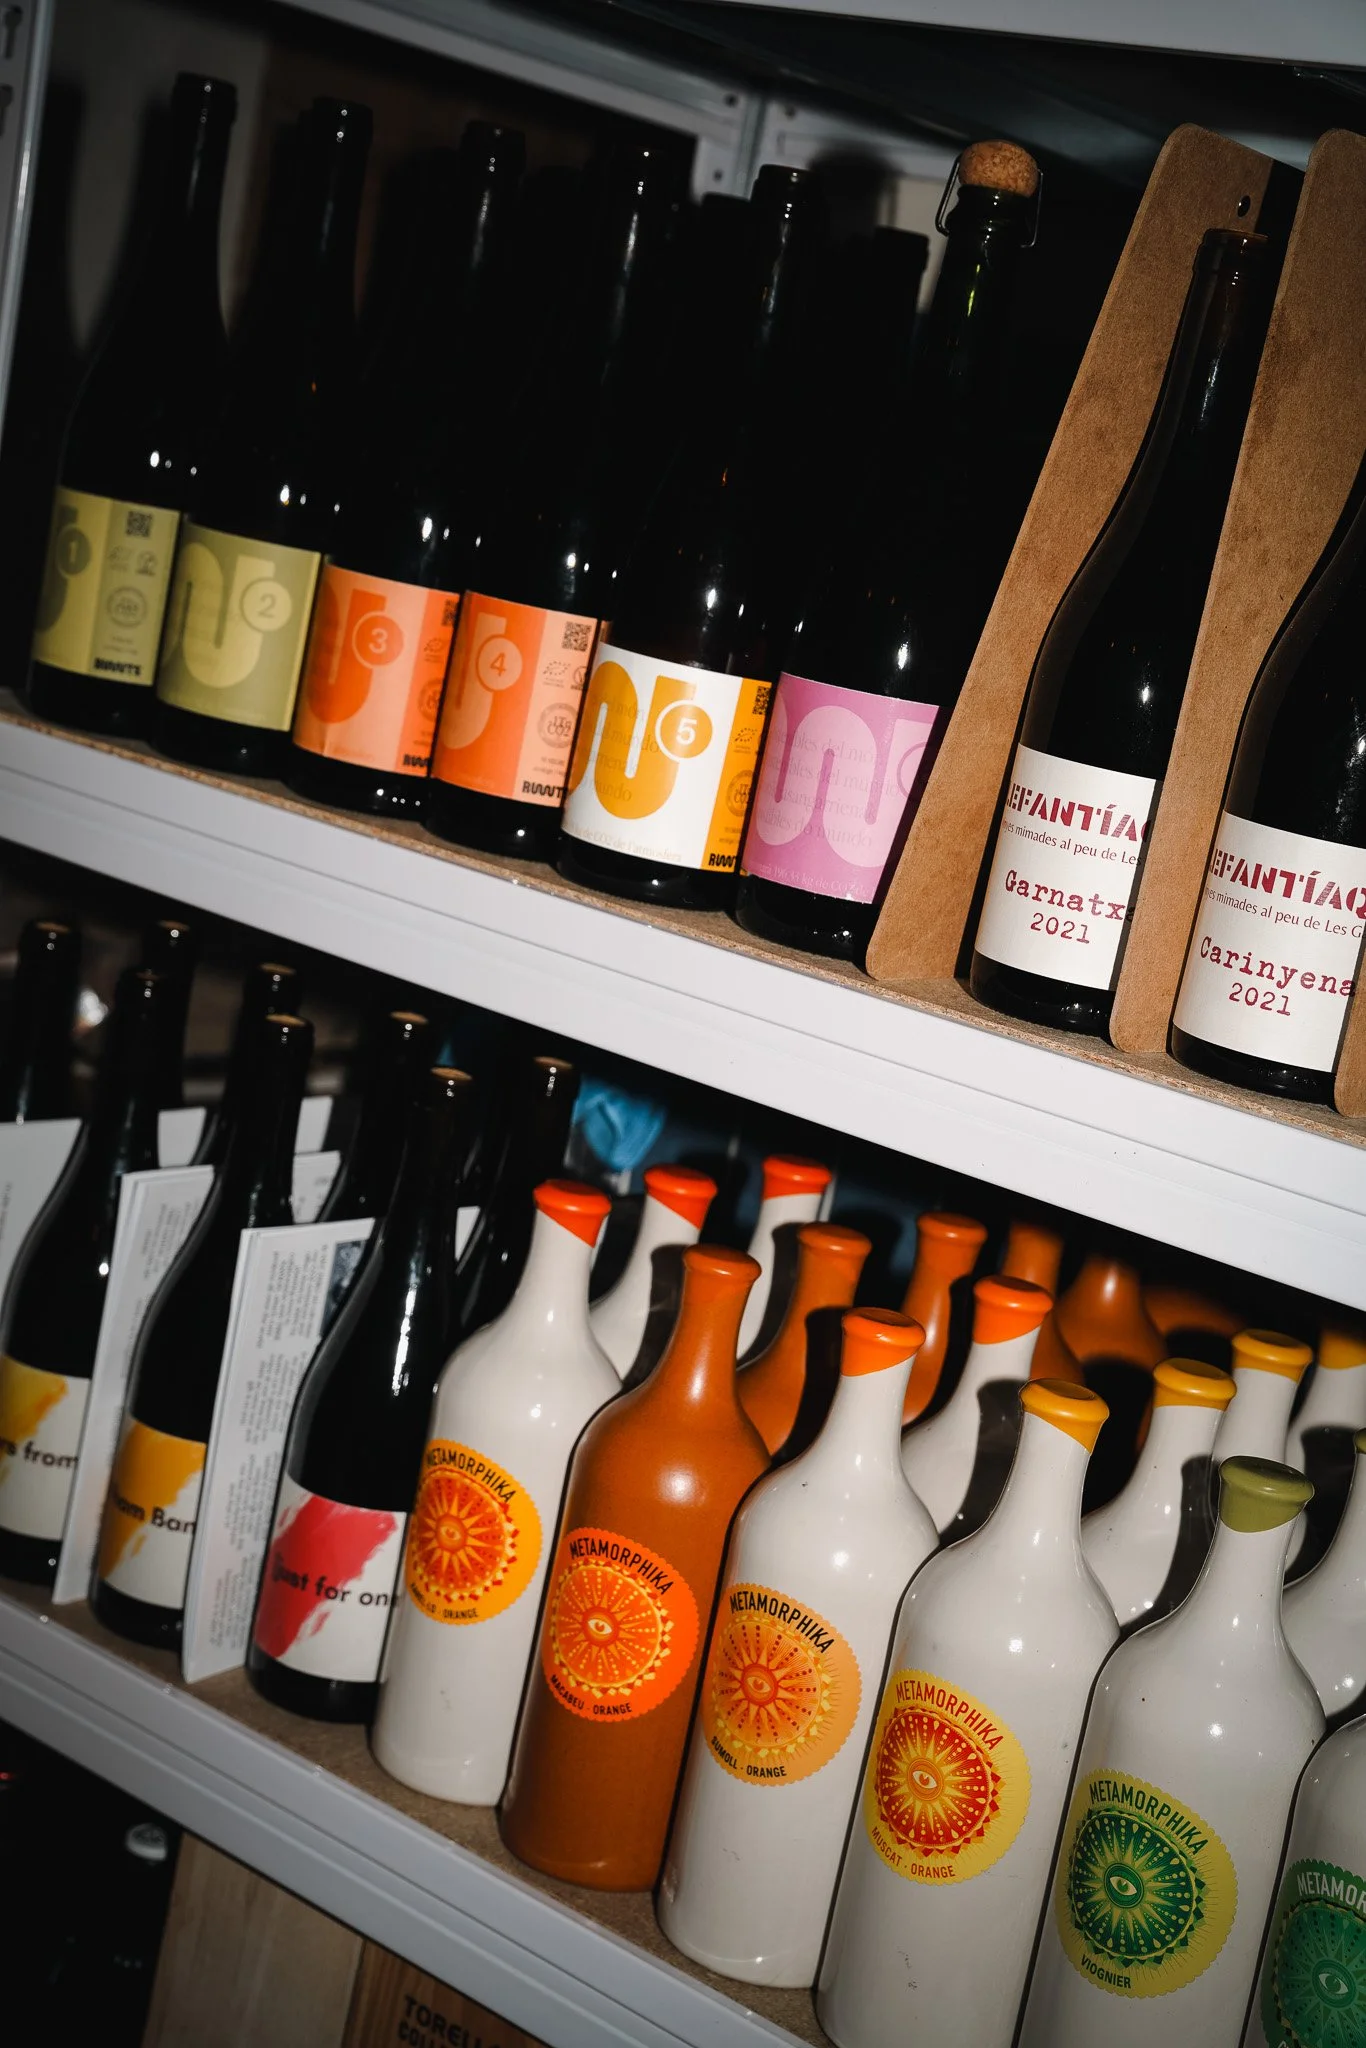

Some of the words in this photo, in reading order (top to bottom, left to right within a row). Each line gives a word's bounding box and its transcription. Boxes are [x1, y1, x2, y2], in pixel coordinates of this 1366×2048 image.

[257, 593, 277, 618] 2
[368, 628, 389, 654] 3
[490, 651, 508, 677] 4
[675, 717, 698, 746] 5
[1006, 783, 1151, 842] EFANTÍA
[1015, 826, 1057, 848] mimades
[1060, 836, 1071, 850] al
[1073, 841, 1098, 858] peu
[1101, 847, 1117, 861] de
[1030, 912, 1091, 944] 2021
[1216, 889, 1258, 915] mimades
[1260, 902, 1273, 919] al
[1275, 909, 1300, 925] peu
[1304, 916, 1321, 931] de
[1325, 919, 1347, 936] Les
[1351, 924, 1366, 940] G
[1200, 936, 1356, 998] Carinyena
[1228, 982, 1291, 1017] 2021
[426, 1447, 516, 1504] METAMORPHIKA
[569, 1537, 674, 1595] METAMORPHIKA
[315, 1574, 351, 1602] for
[729, 1590, 835, 1654] METAMORPHIKA
[550, 1674, 585, 1710] MACABEU
[593, 1703, 632, 1716] ORANGE
[896, 1680, 1004, 1751] METAMORPHIKA
[711, 1735, 738, 1770] SUMOLL
[746, 1764, 788, 1779] ORANGE
[1089, 1780, 1209, 1856] METAMORPHIKA
[871, 1826, 902, 1867] MUSCAT
[911, 1863, 956, 1879] ORANGE
[1080, 1954, 1132, 1990] VIOGNIER
